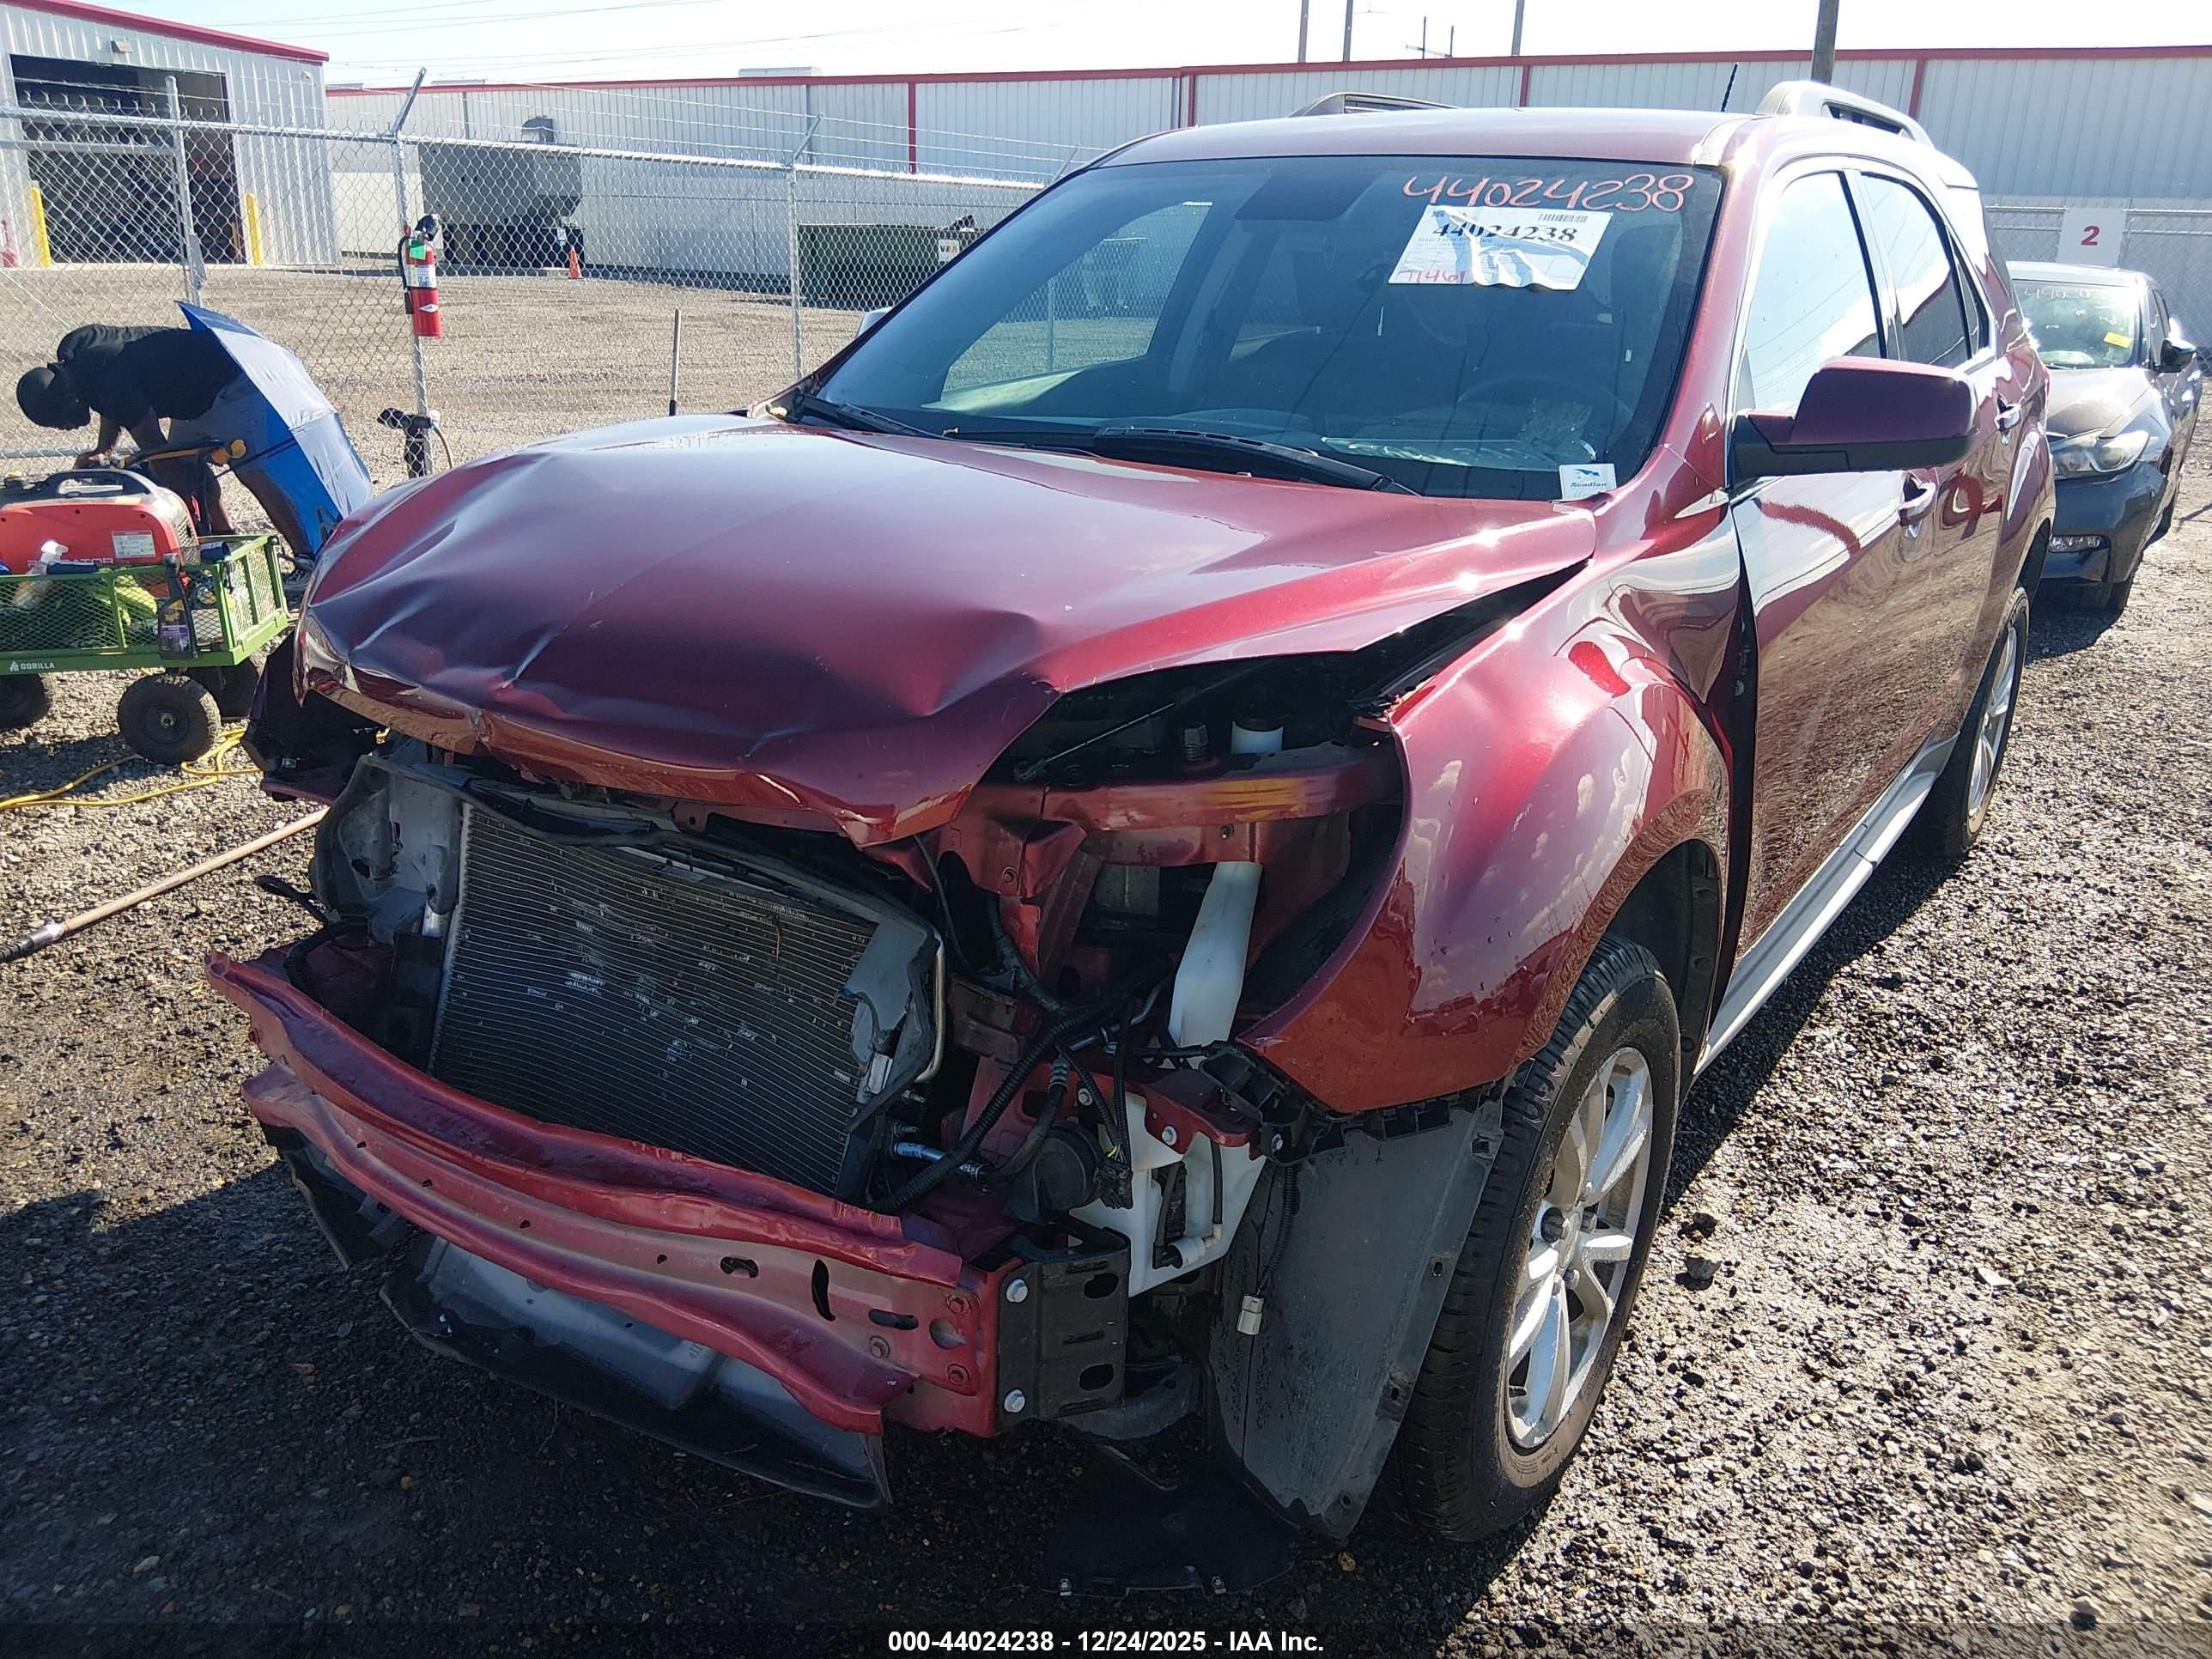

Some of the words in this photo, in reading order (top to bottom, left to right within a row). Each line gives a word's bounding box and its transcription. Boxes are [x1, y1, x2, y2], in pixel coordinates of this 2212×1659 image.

[1403, 173, 1694, 211] 44024238
[1432, 222, 1577, 241] 44024238
[2081, 226, 2100, 246] 2
